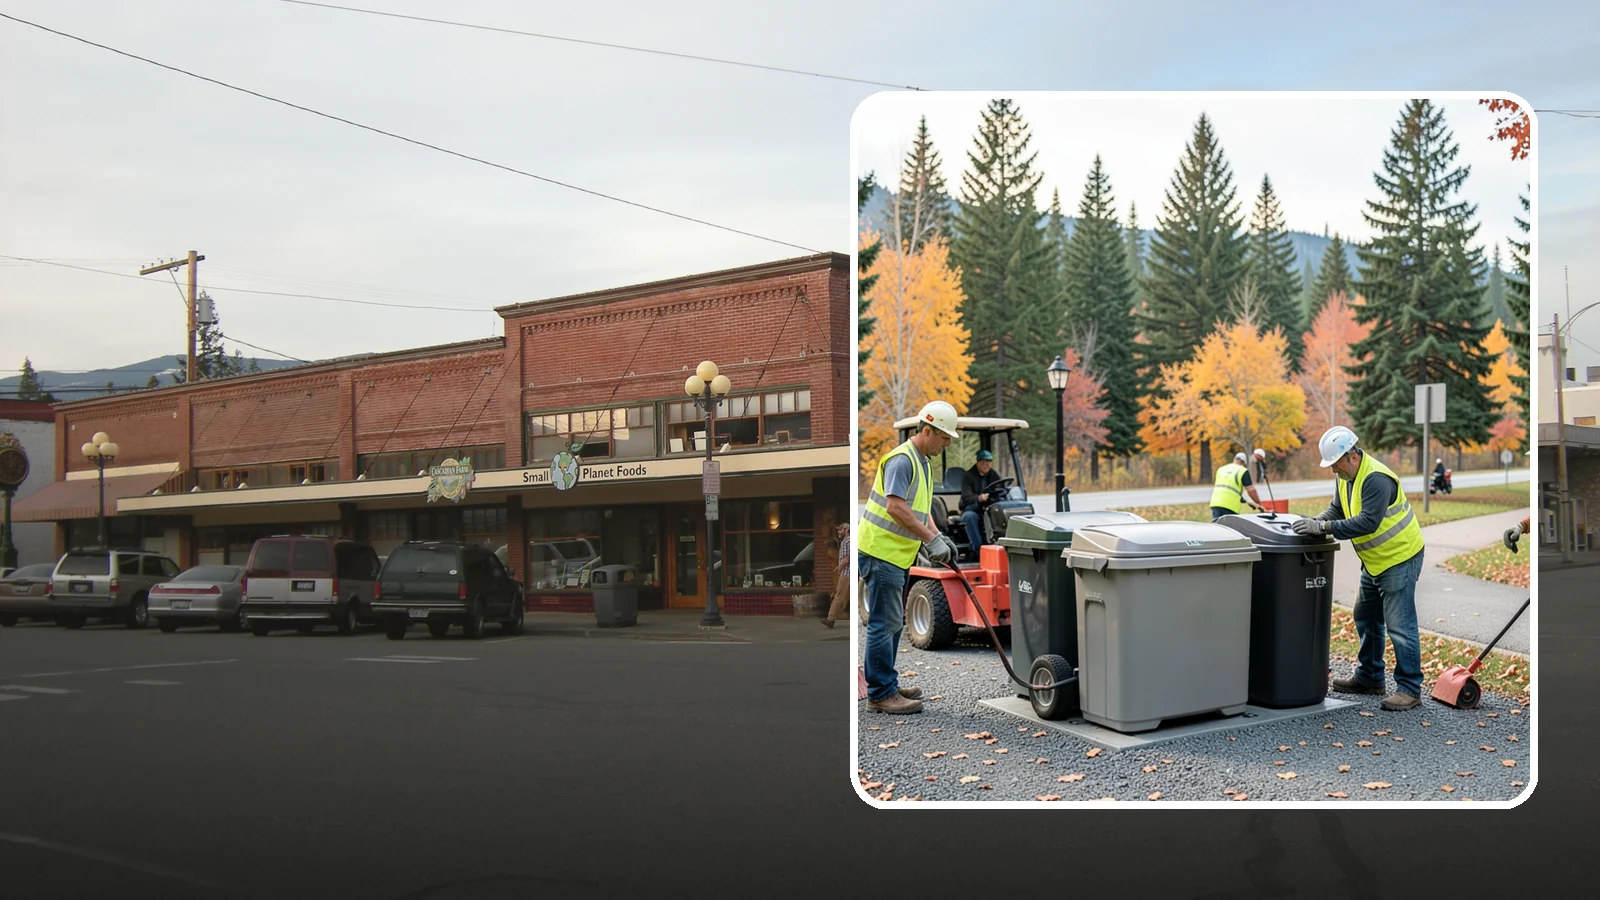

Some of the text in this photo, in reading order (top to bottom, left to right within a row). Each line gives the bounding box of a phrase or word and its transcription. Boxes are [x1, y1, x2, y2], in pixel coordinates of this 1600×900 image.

[431, 466, 469, 476] CASCADIAN FARM
[523, 464, 647, 483] Small Planet Foods
